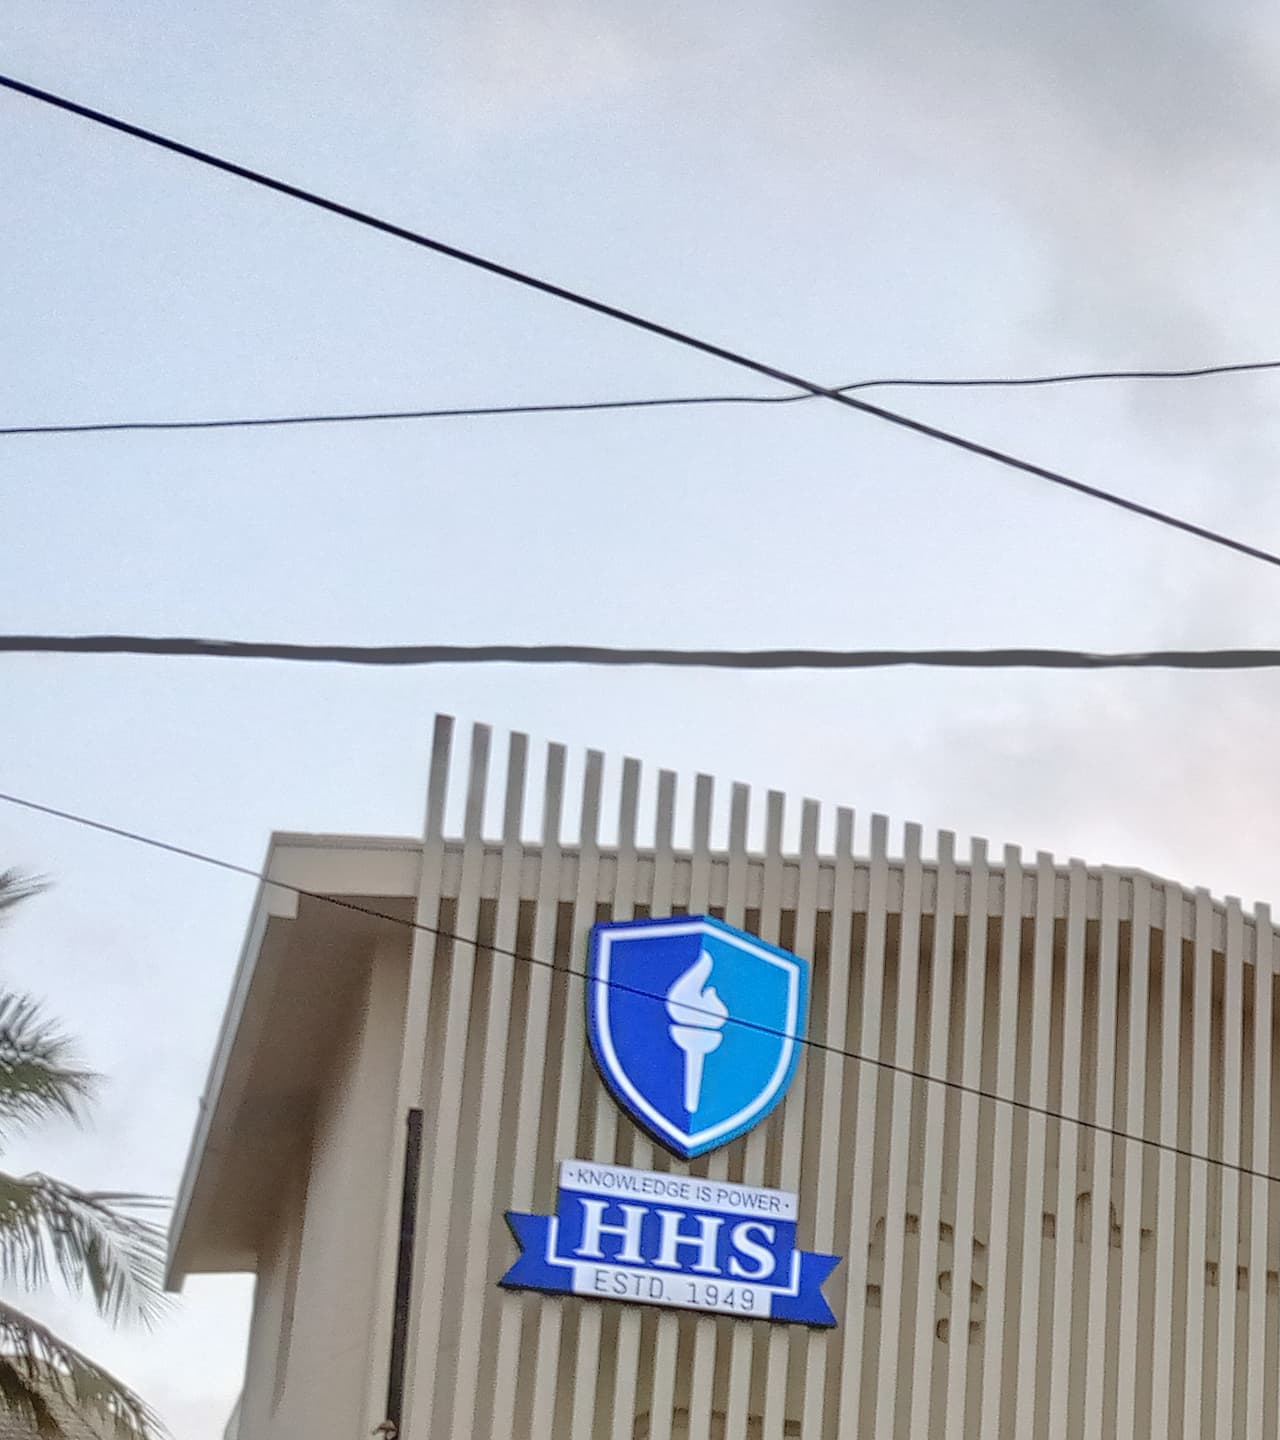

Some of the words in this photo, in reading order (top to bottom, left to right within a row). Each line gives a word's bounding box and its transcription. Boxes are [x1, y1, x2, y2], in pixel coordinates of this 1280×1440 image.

[577, 1168, 691, 1200] KNOWLEDGE
[696, 1186, 713, 1202] IS
[717, 1188, 781, 1212] POWER
[573, 1199, 776, 1280] HHS
[687, 1282, 755, 1312] 1949
